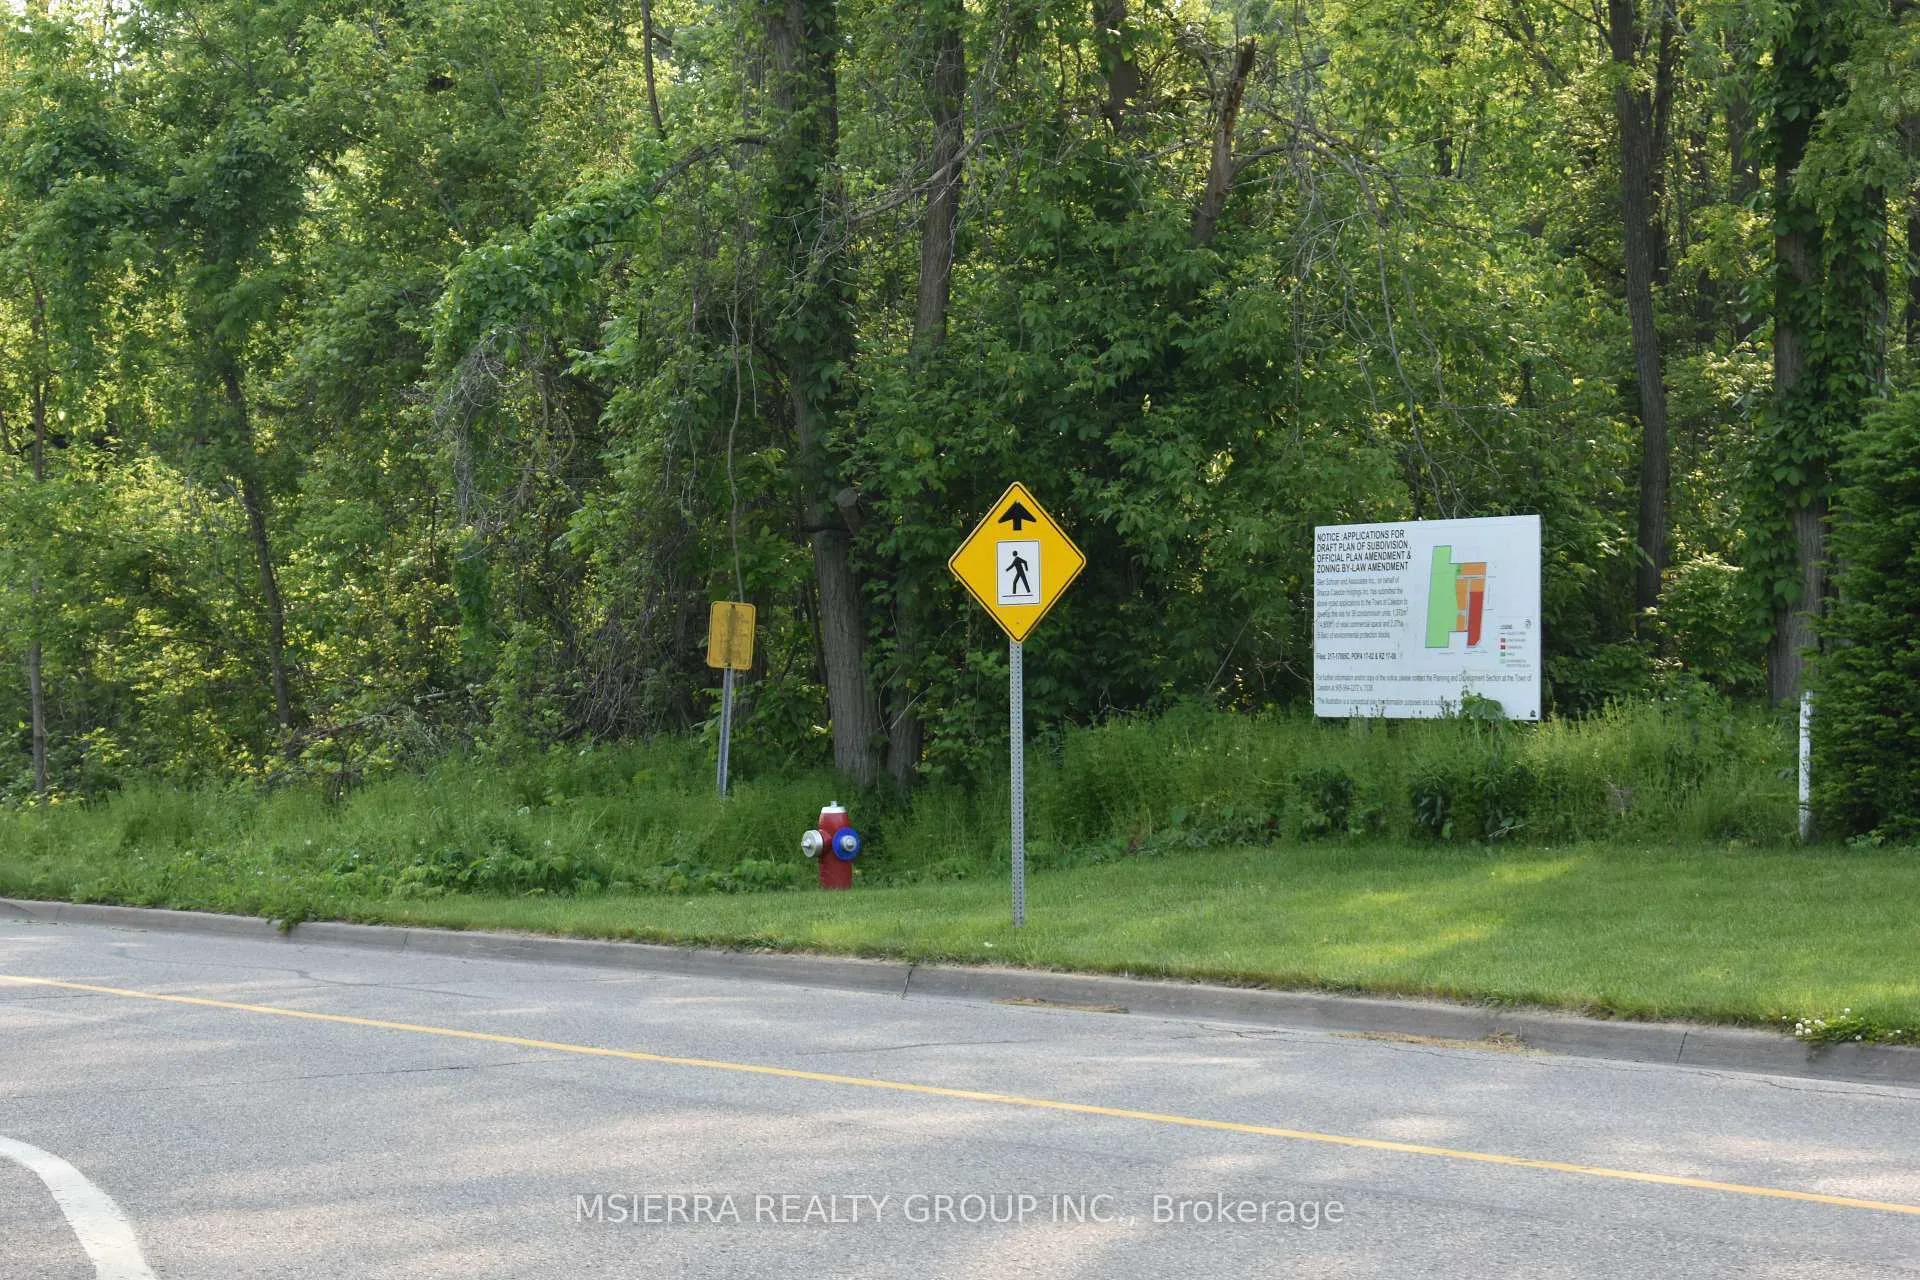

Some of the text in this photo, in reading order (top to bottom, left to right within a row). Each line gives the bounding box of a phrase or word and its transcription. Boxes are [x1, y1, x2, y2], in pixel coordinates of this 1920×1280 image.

[1343, 530, 1389, 541] APPLICATIONS
[1391, 529, 1405, 539] FOR
[1317, 543, 1337, 552] DRAFT
[1338, 542, 1355, 552] PLAN
[1356, 541, 1366, 551] OF
[1317, 550, 1411, 563] OFFICIAL PLAN AMENDMENT &
[1316, 561, 1409, 574] ZONING BY-LAW AMENDMENT
